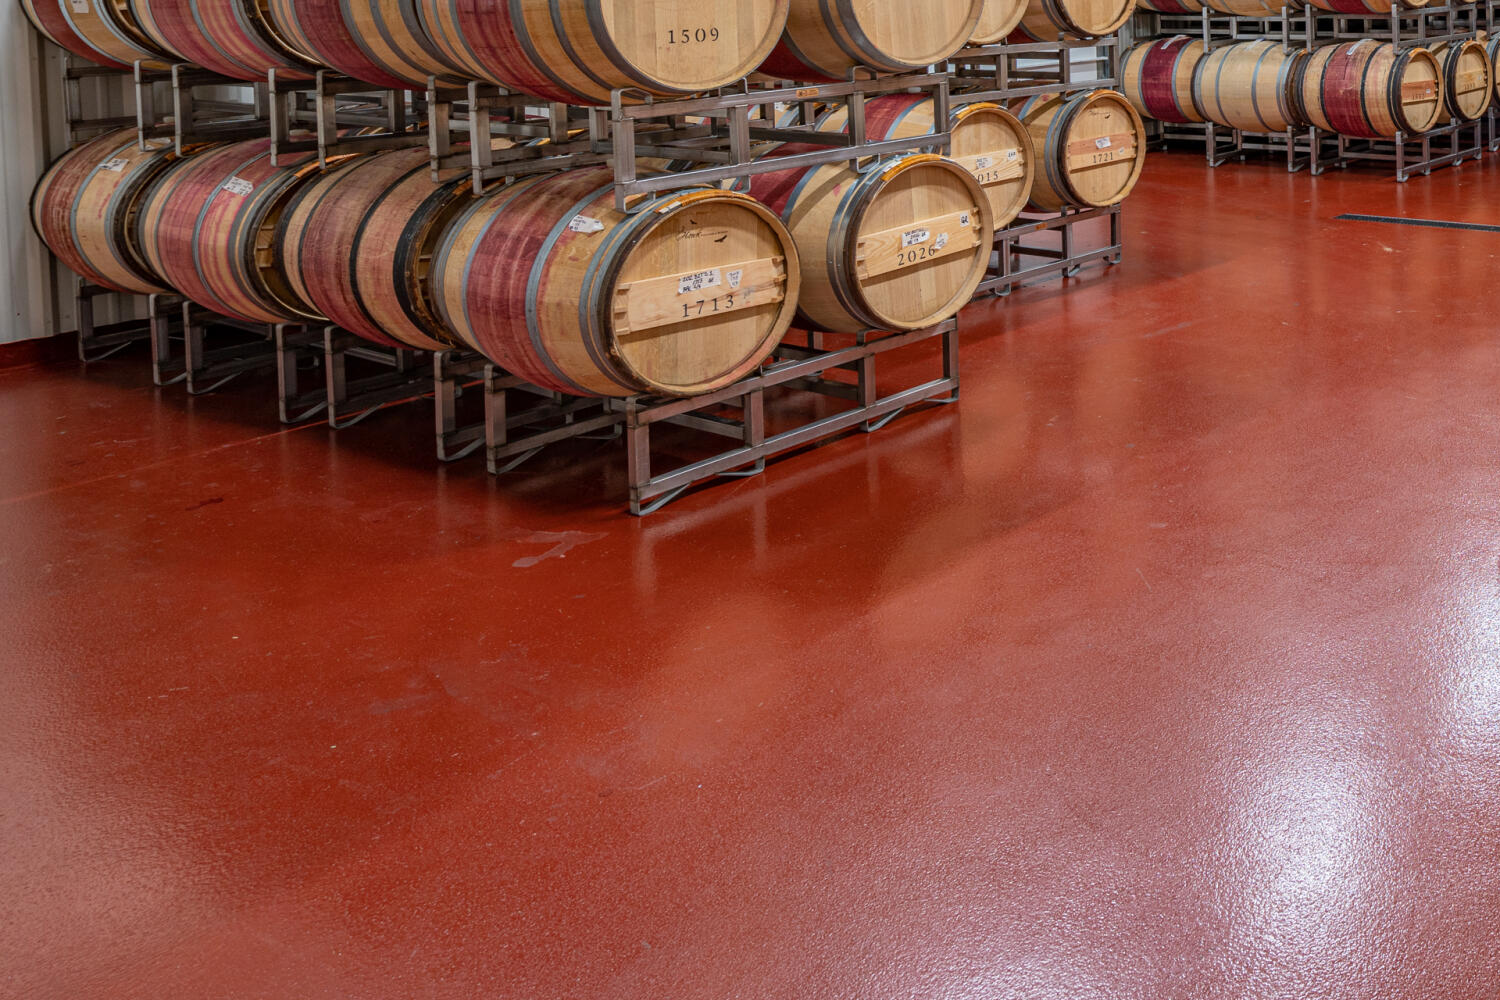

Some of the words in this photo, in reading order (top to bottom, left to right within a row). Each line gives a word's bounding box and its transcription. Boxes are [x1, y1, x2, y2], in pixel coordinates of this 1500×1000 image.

[667, 27, 719, 45] 1509
[1092, 151, 1114, 164] 1721
[976, 170, 999, 184] 015
[896, 245, 935, 267] 2026
[682, 294, 735, 318] 1713
